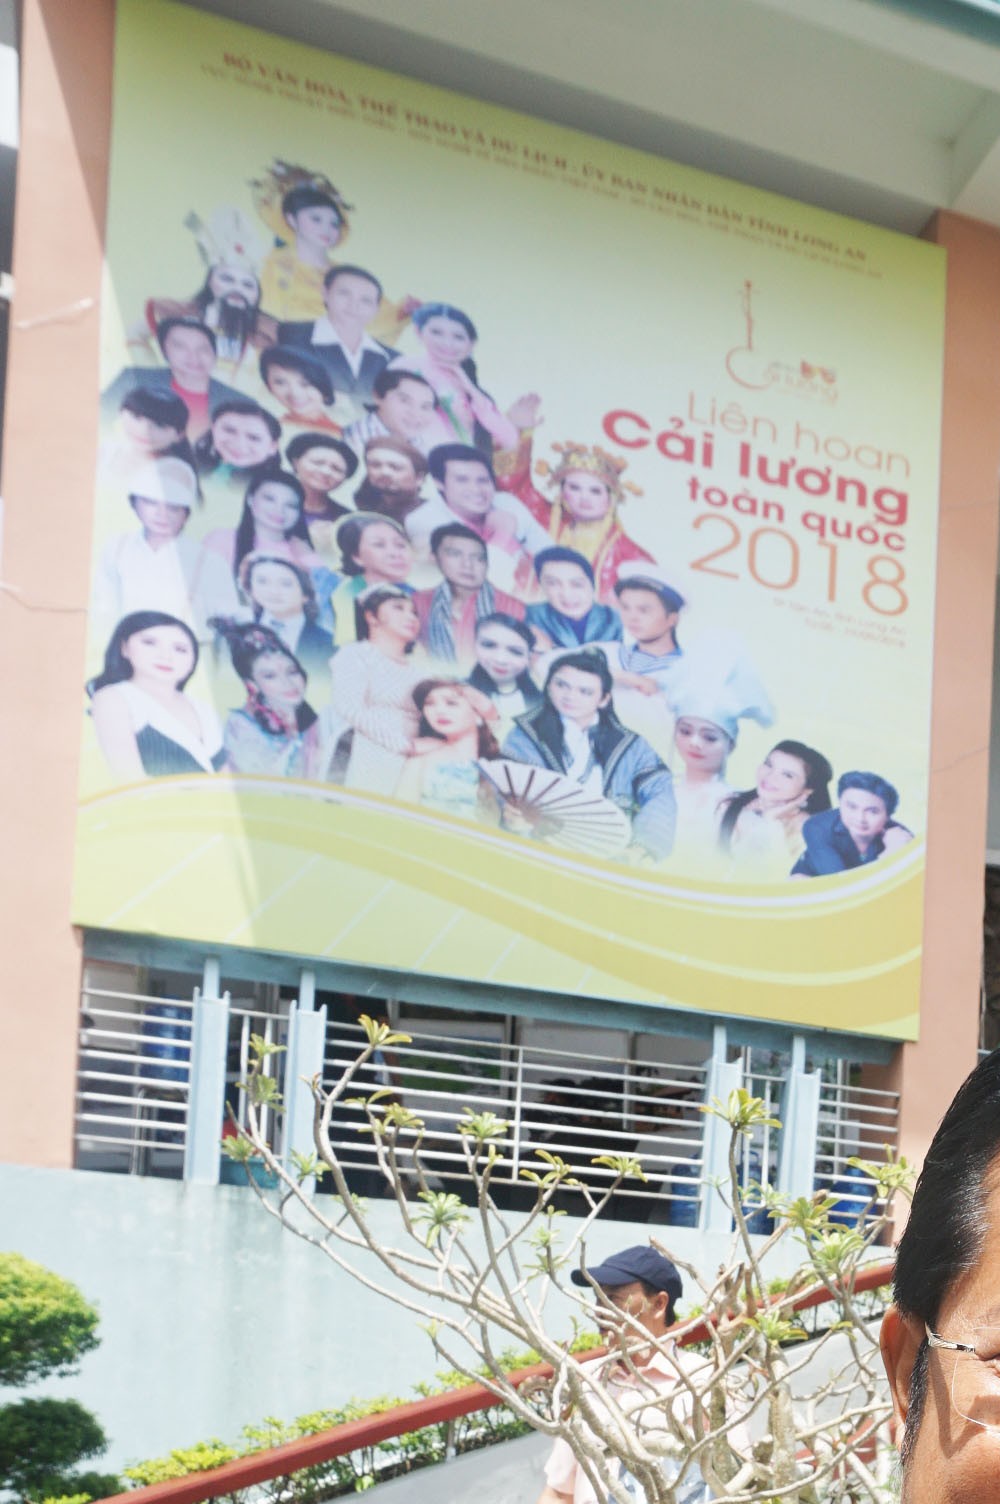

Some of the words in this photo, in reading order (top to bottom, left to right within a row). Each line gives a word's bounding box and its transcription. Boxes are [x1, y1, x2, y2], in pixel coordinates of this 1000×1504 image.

[602, 408, 714, 470] Cải
[739, 441, 910, 528] lương
[688, 390, 778, 445] Liên
[794, 421, 911, 479] hoan
[687, 475, 785, 523] toàn
[800, 508, 907, 552] quốc
[688, 512, 910, 617] 2018
